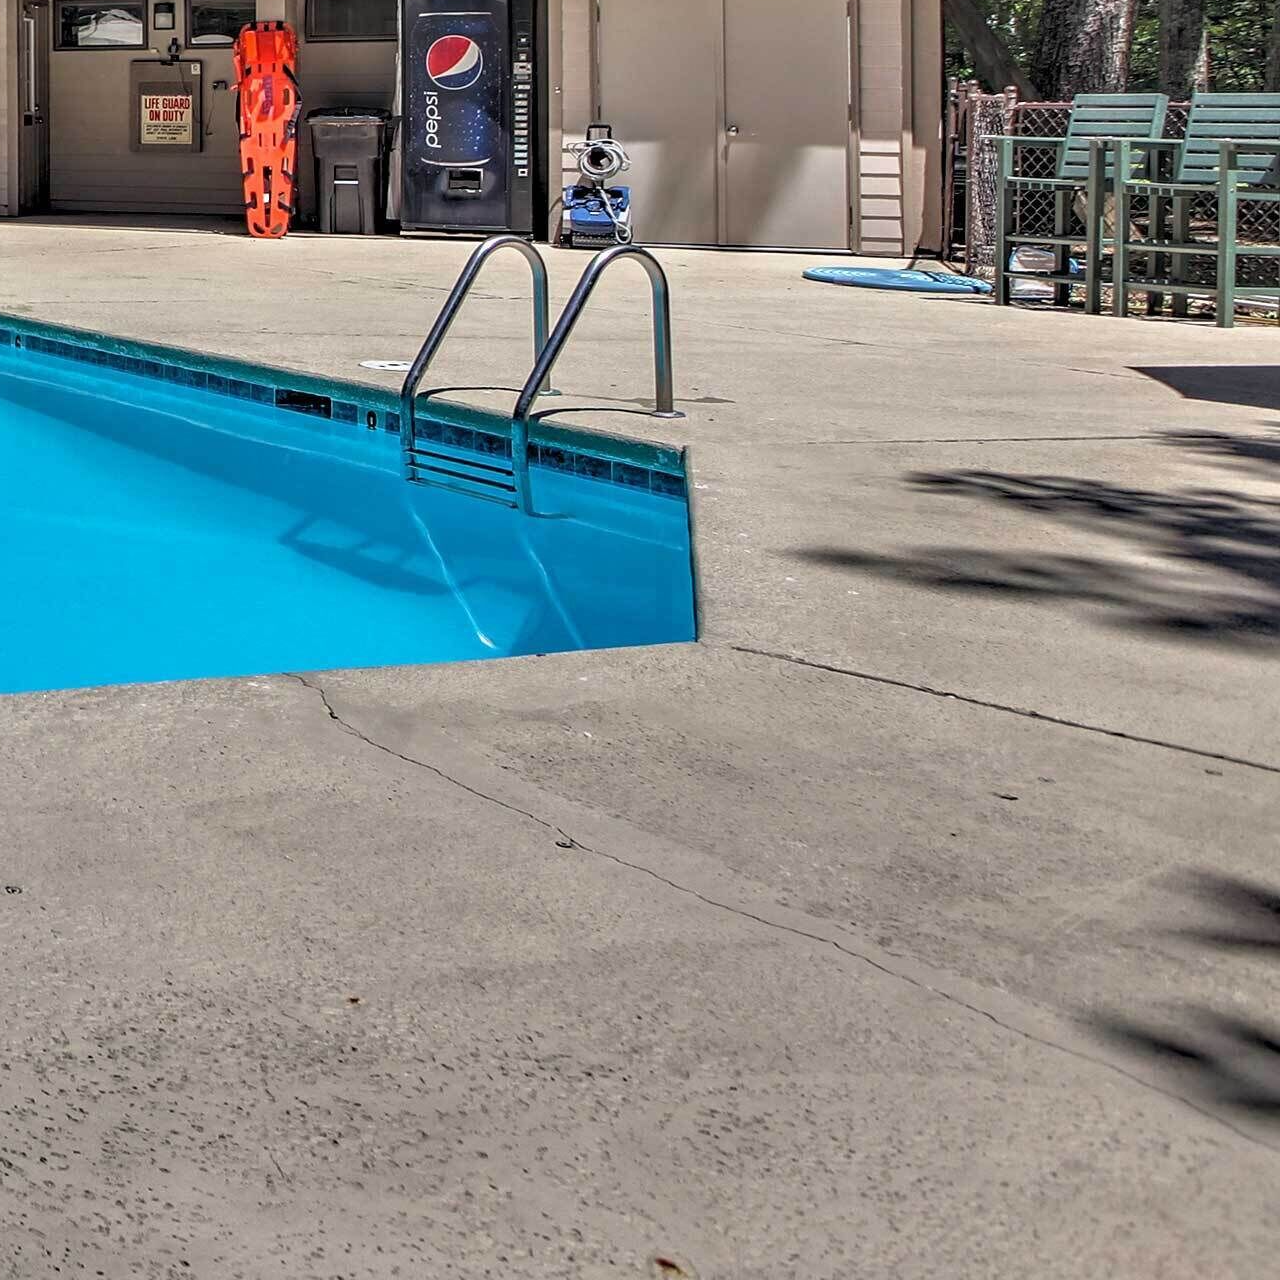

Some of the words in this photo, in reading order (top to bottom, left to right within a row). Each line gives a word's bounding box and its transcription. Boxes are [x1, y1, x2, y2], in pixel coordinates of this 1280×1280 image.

[144, 98, 160, 109] LIFE
[162, 98, 190, 109] GUARD
[149, 110, 161, 121] ON
[162, 110, 184, 121] DUTY
[423, 91, 442, 149] pepsi
